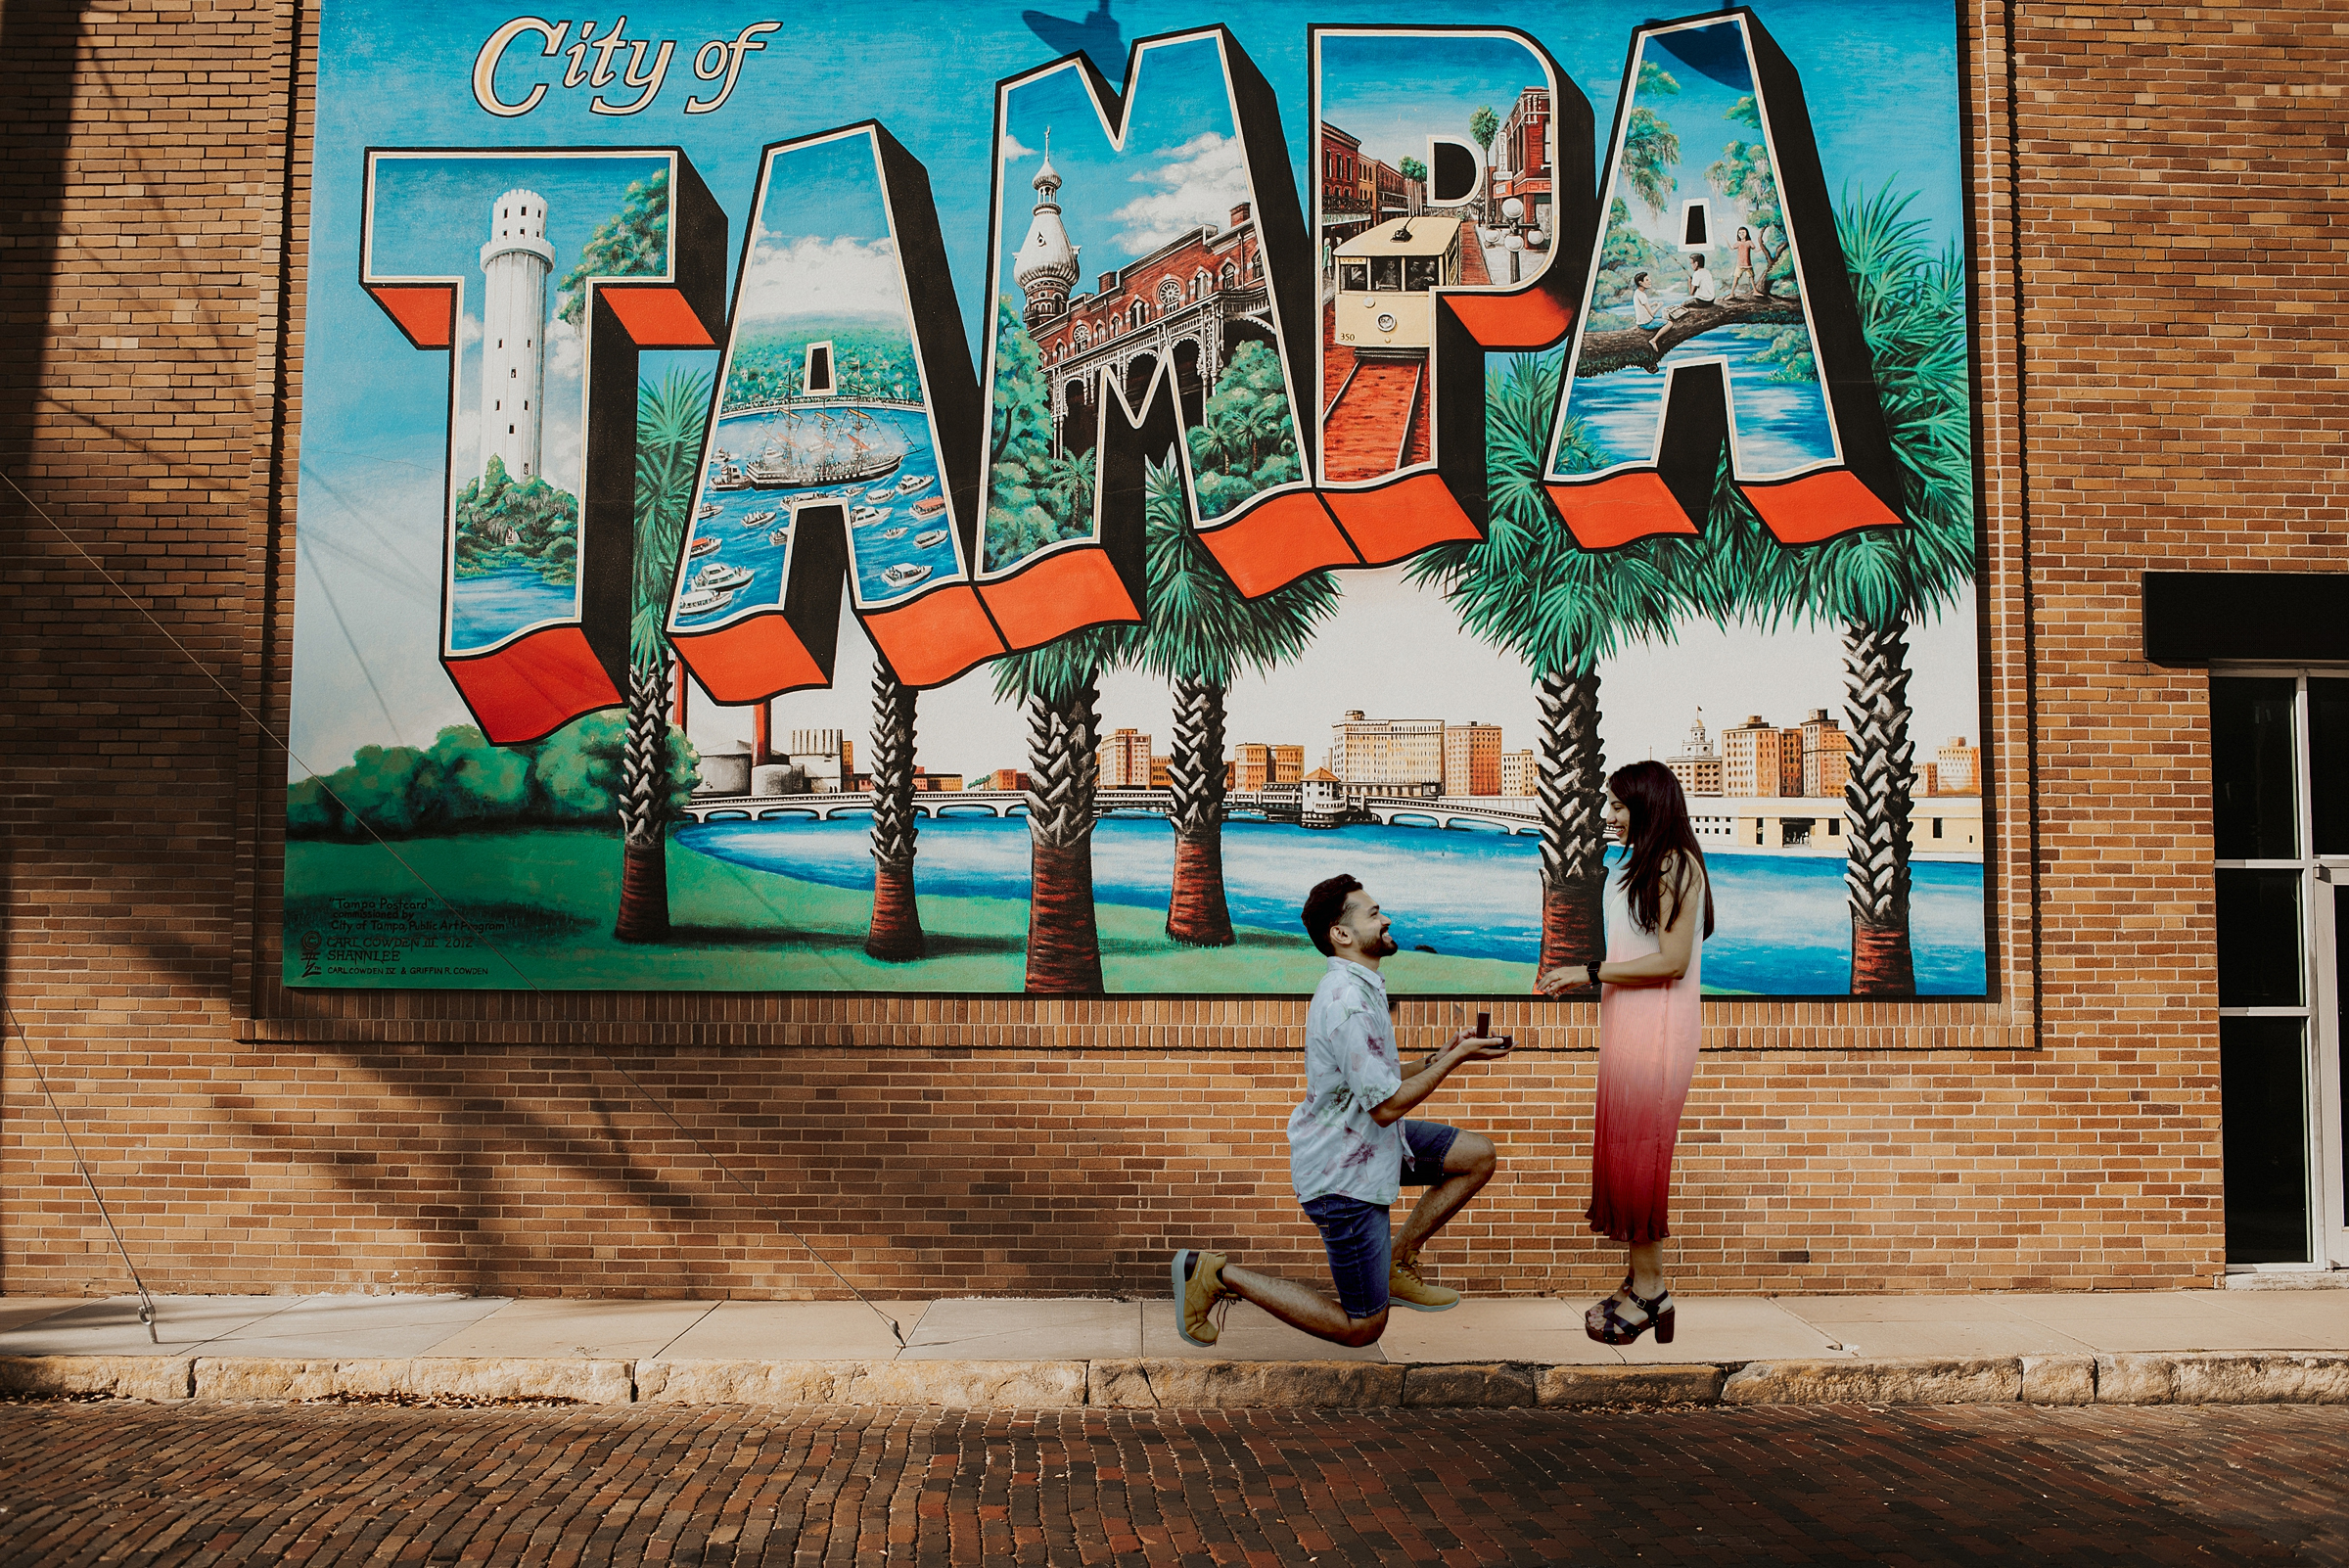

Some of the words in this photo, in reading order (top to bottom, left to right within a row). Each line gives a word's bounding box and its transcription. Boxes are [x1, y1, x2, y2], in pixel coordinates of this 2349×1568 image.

[472, 16, 677, 117] City
[683, 22, 783, 115] of
[1340, 333, 1356, 342] 350
[360, 5, 1905, 747] TAMPA
[333, 909, 399, 919] commissioned
[401, 910, 414, 921] by
[330, 920, 352, 934] City
[356, 920, 367, 931] of
[408, 920, 438, 931] Public
[440, 920, 460, 931] Art
[461, 920, 505, 934] Program
[326, 937, 365, 950] CARL
[363, 937, 420, 952] COWDEN
[444, 937, 474, 948] 2012
[409, 966, 443, 975] GRIFFIN
[453, 967, 488, 976] COWDEN
